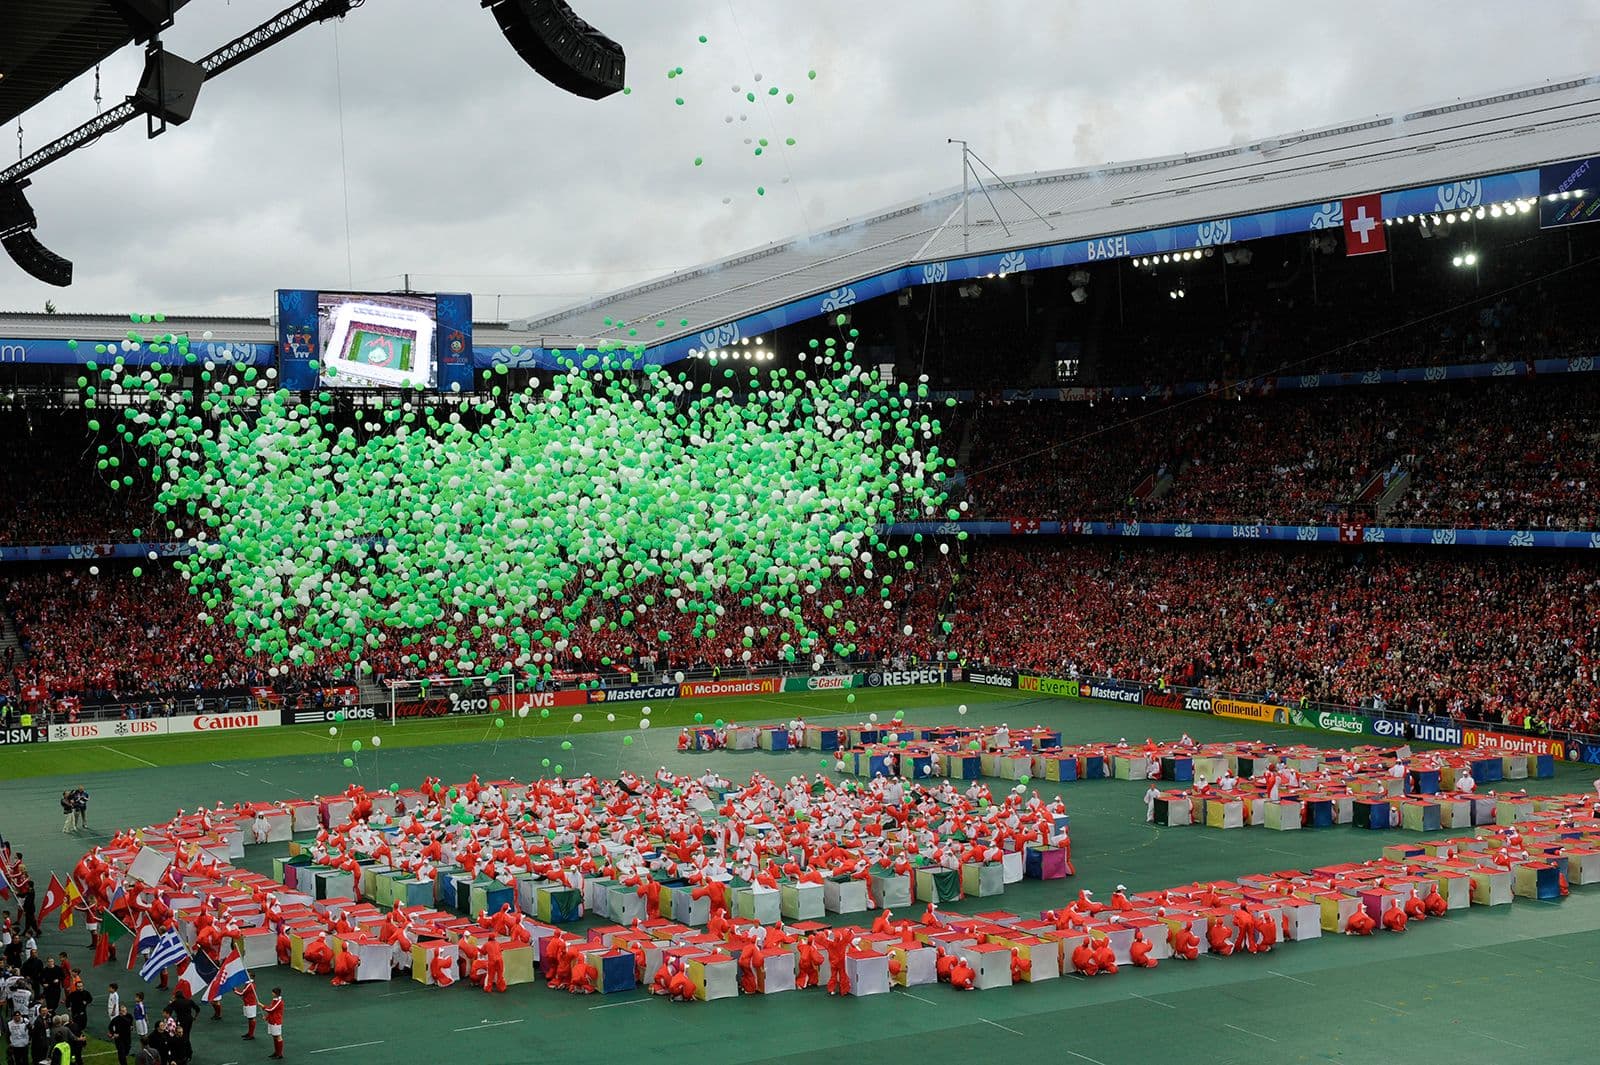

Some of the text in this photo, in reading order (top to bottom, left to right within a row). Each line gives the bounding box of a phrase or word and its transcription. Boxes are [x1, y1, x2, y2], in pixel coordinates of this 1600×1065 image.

[1558, 160, 1591, 193] RESPECT
[1087, 235, 1131, 260] BASEL
[1232, 525, 1260, 538] BASEL
[818, 677, 850, 688] Castr
[882, 669, 947, 686] RESPECT
[985, 674, 1012, 687] adidas
[607, 686, 676, 701] MasterCard
[694, 683, 760, 694] McDonald's
[1020, 677, 1078, 696] JVC Everio
[526, 692, 554, 708] JVC
[1091, 686, 1140, 703] MasterCard
[451, 698, 488, 713] zero
[1184, 697, 1211, 711] zero
[1213, 700, 1262, 717] Continental
[131, 721, 158, 733] UBS
[193, 714, 259, 730] Canon
[1319, 711, 1363, 733] Carlsberg
[71, 725, 98, 737] UBS
[1394, 721, 1461, 744] HUNDAI
[1537, 740, 1548, 754] it
